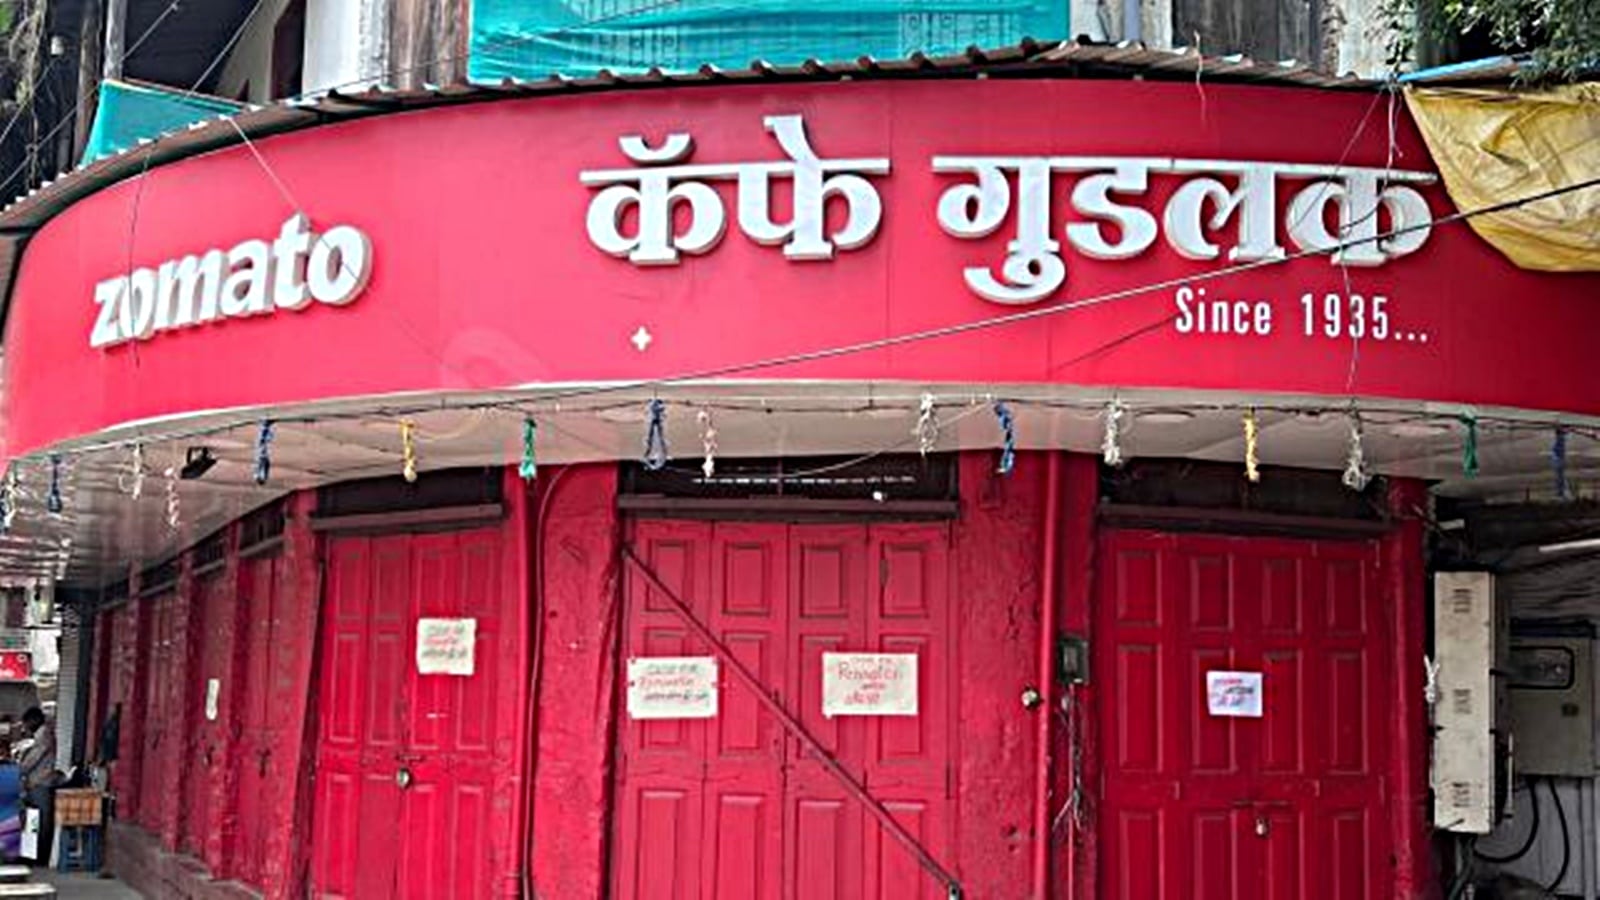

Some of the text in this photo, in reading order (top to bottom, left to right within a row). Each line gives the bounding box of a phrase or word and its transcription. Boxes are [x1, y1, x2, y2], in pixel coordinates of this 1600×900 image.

[580, 114, 1438, 305] कॅफे गुडलक
[90, 212, 372, 348] zomato
[1175, 287, 1428, 342] Since 1935...
